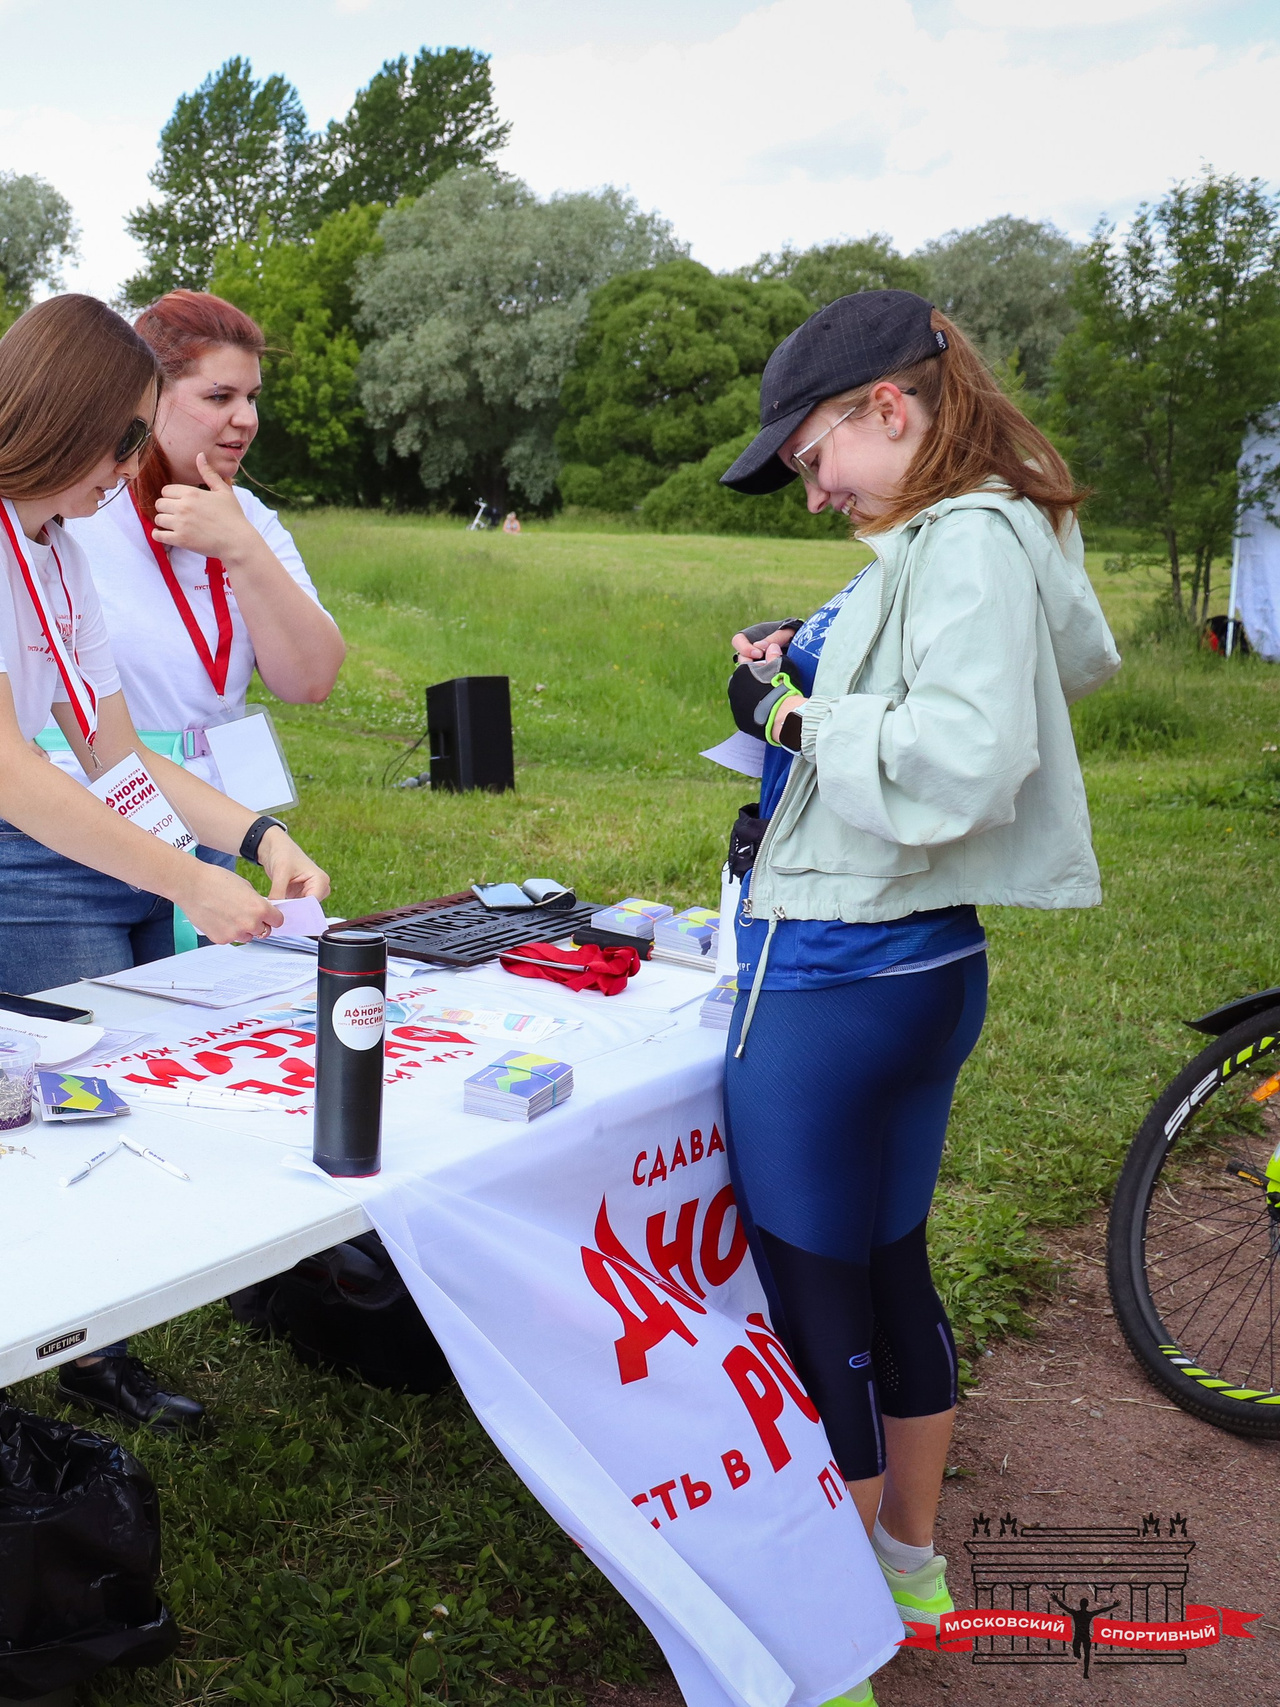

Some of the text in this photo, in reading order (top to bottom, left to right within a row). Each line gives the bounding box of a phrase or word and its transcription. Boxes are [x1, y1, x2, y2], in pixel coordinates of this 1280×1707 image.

[118, 783, 156, 816] ОССИИ
[383, 910, 499, 943] FITNESS
[632, 1122, 726, 1188] СДАВА
[42, 1333, 81, 1355] LIFETIME
[720, 1449, 751, 1491] В
